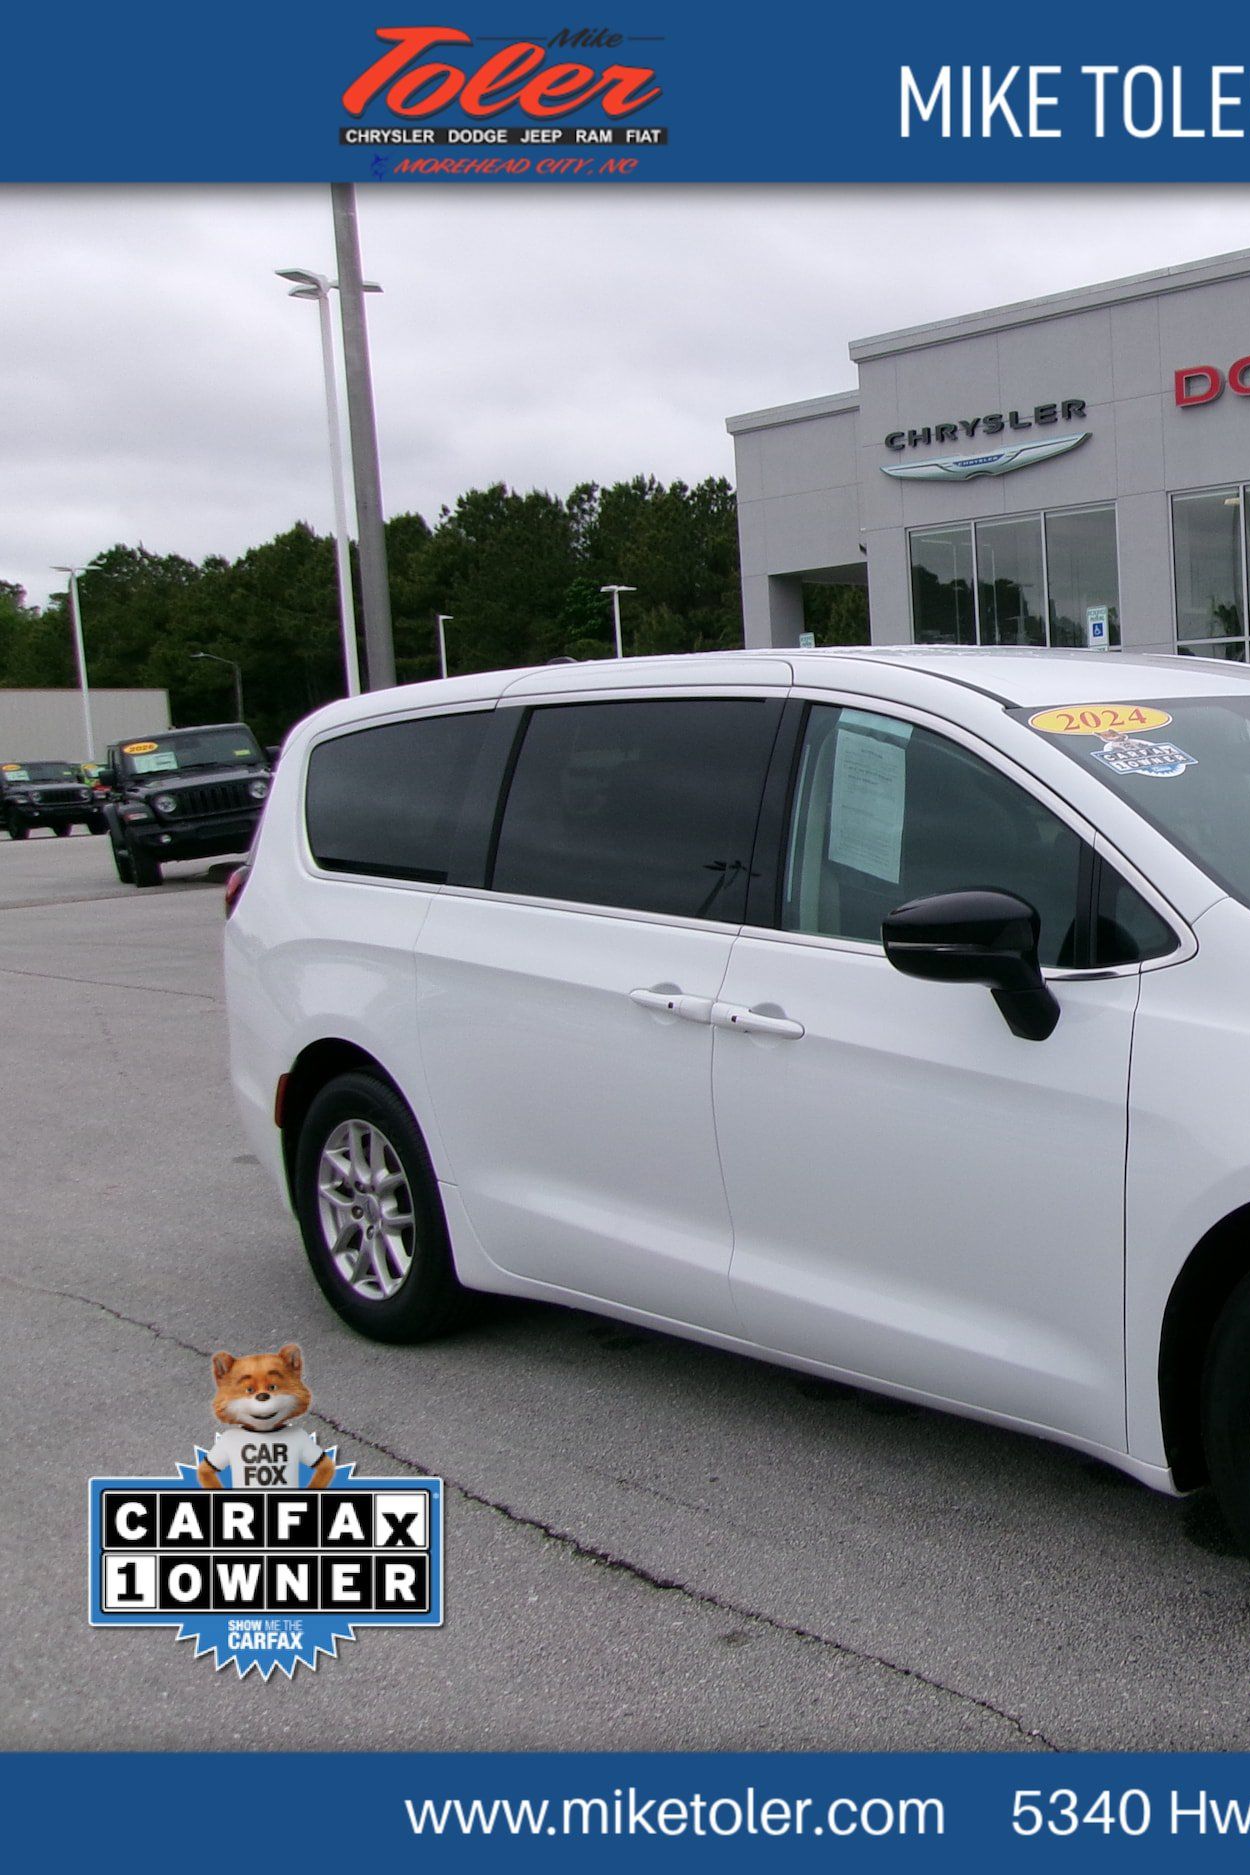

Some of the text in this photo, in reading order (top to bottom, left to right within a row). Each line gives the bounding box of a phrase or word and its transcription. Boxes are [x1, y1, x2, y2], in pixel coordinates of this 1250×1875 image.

[884, 399, 1087, 451] CHRYSLER
[1056, 707, 1147, 731] 2024
[1103, 745, 1176, 761] CARFAX
